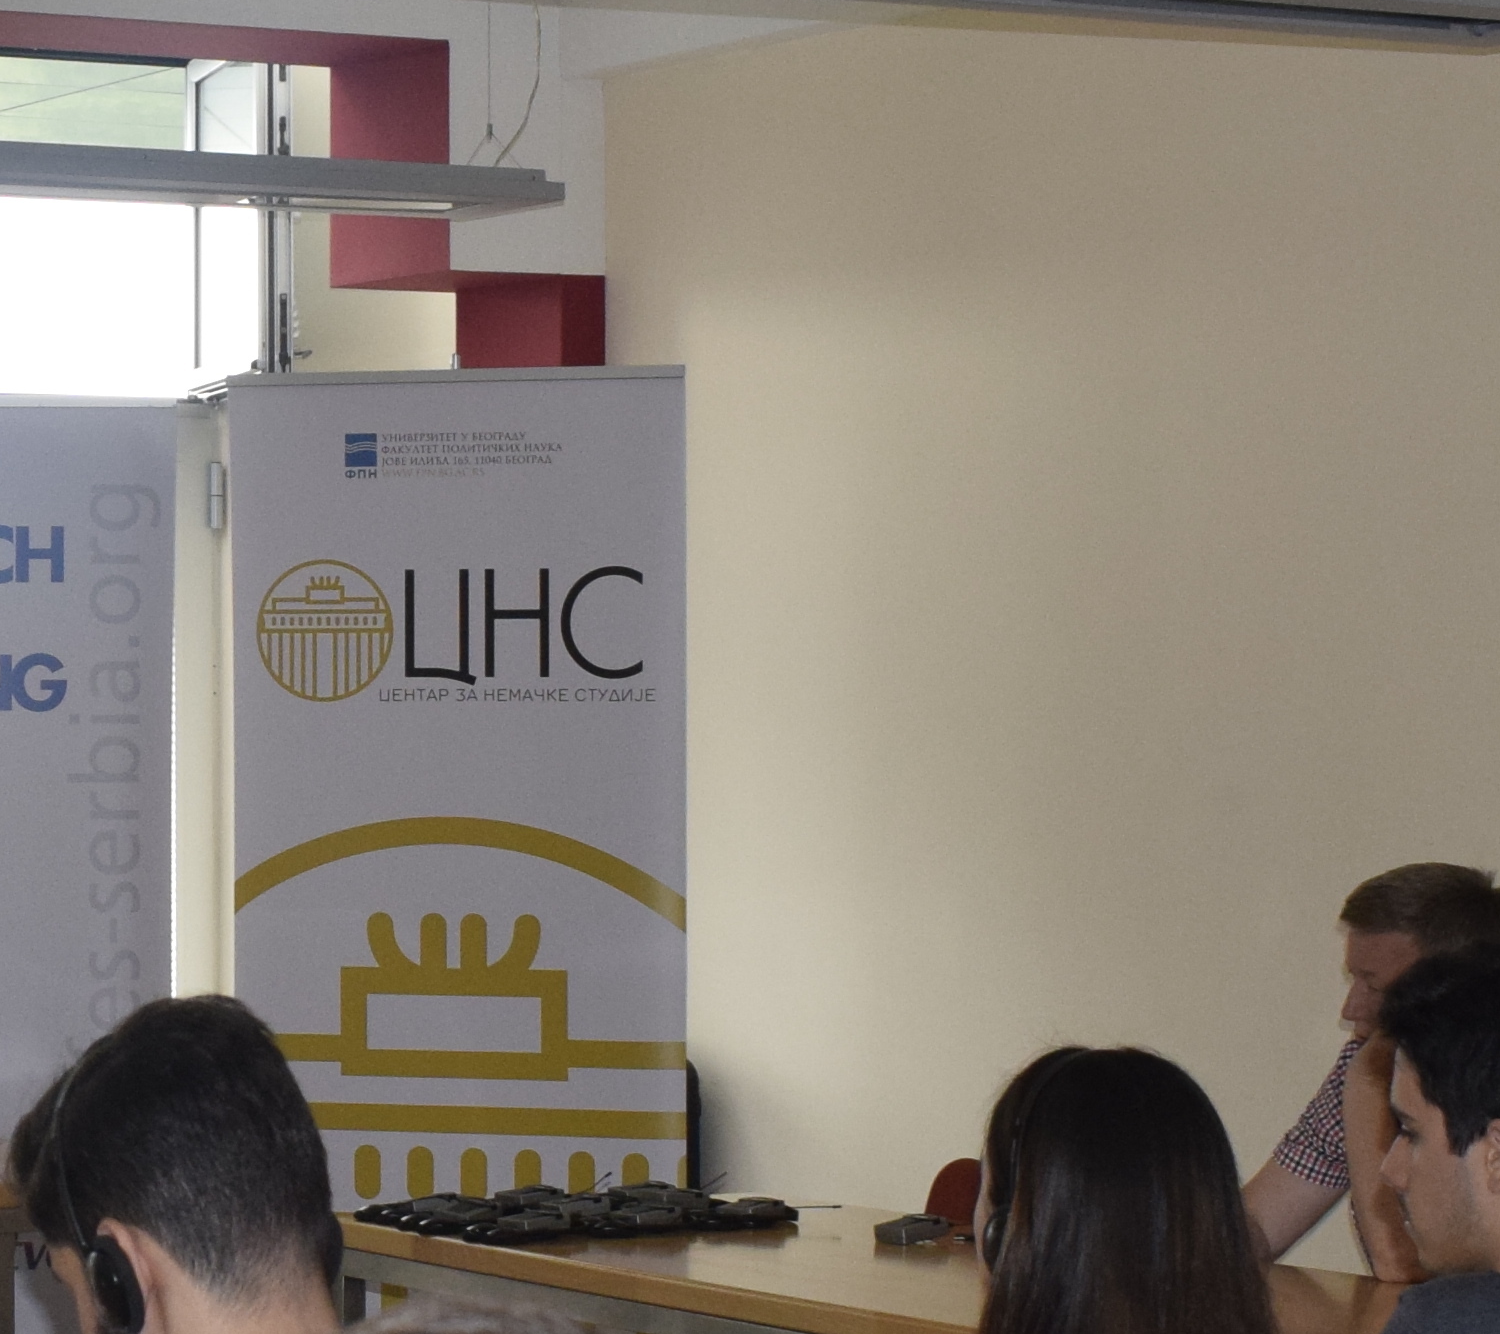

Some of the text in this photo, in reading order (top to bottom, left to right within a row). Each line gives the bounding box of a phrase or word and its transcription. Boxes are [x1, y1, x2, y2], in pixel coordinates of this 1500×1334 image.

[381, 432, 526, 442] УНИВЕРЗИТЕТ У БЕОГРАДУ
[381, 442, 562, 454] ФАКУЛТЕТ ПОЛИТИЧКИХ НАУКА
[505, 455, 552, 464] БЕОГРАД
[345, 469, 377, 479] ФПН
[405, 565, 644, 686] ЦНС
[379, 688, 657, 703] ЦЕНТАР ЗА НЕМАЧКЕ СТУДИЈЕ
